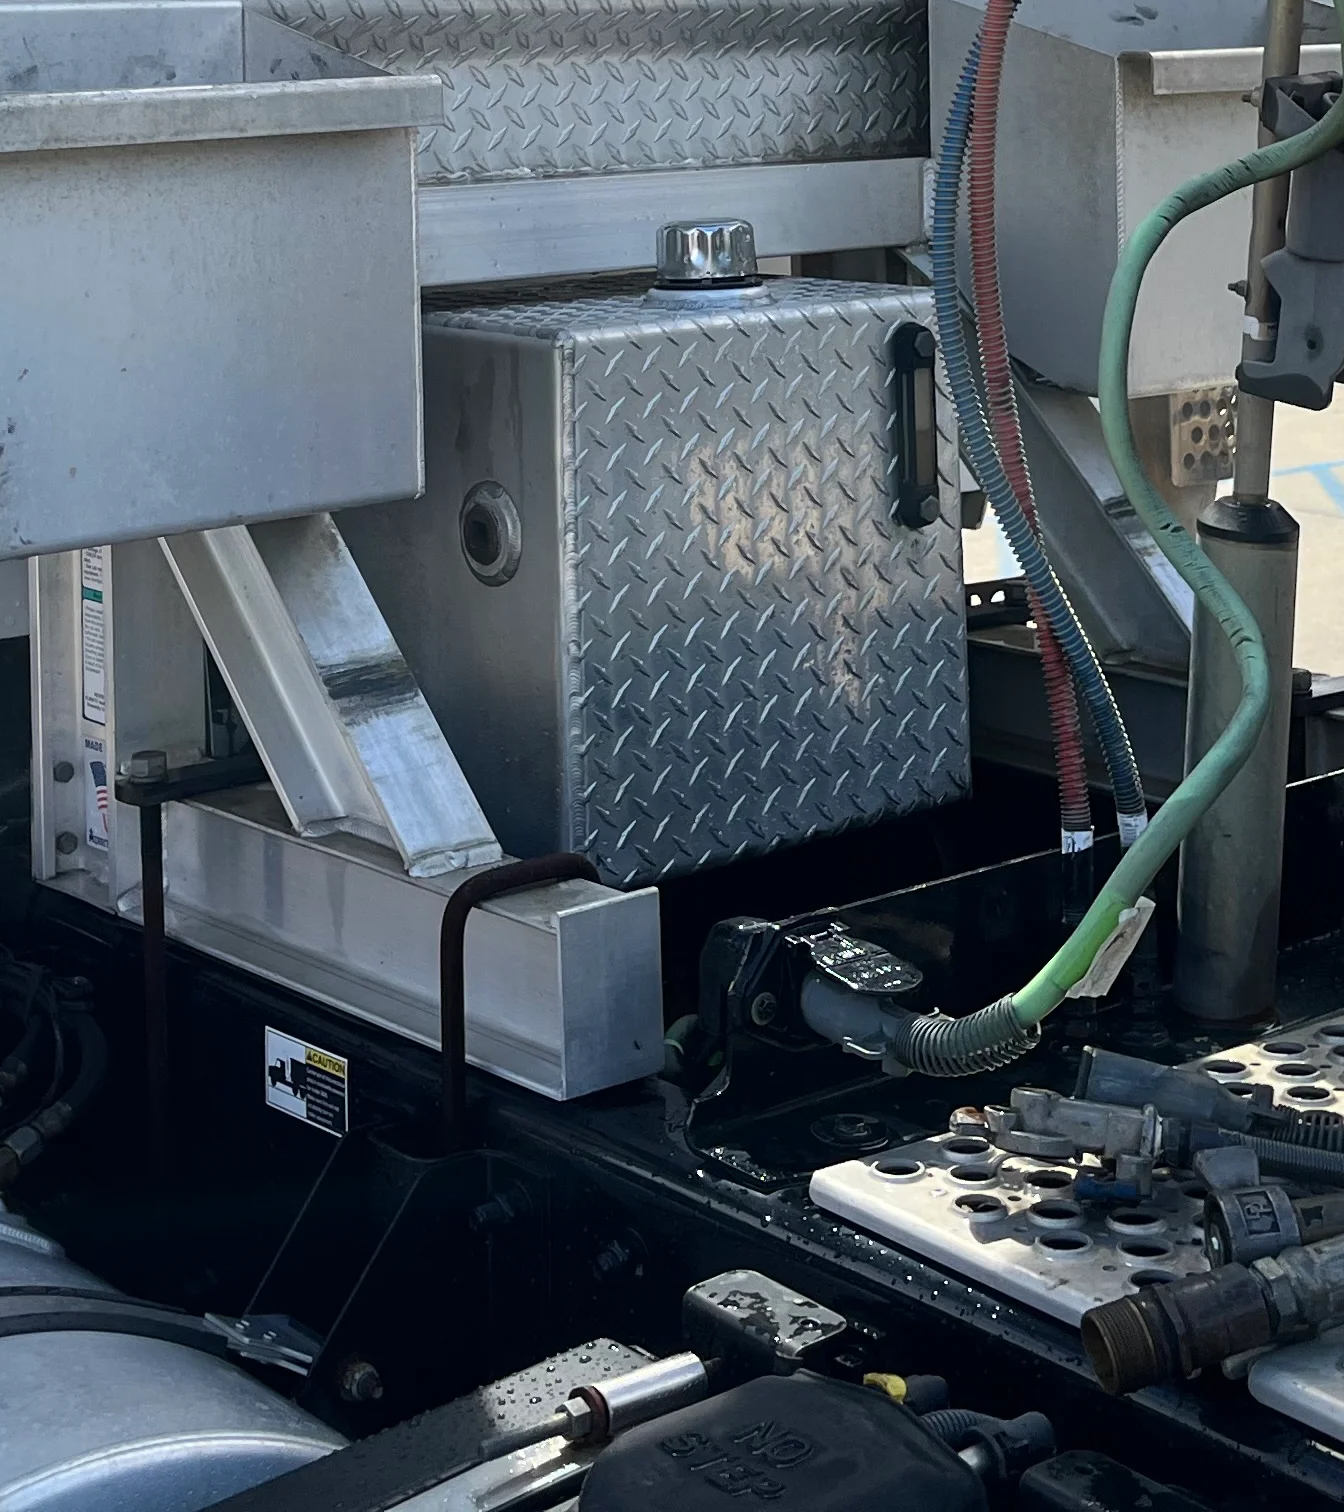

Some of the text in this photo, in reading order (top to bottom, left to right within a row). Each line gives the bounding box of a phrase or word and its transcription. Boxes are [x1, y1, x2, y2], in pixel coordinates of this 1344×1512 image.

[312, 1053, 345, 1075] CAUTION
[660, 1432, 786, 1499] STEP
[733, 1420, 814, 1469] NO
